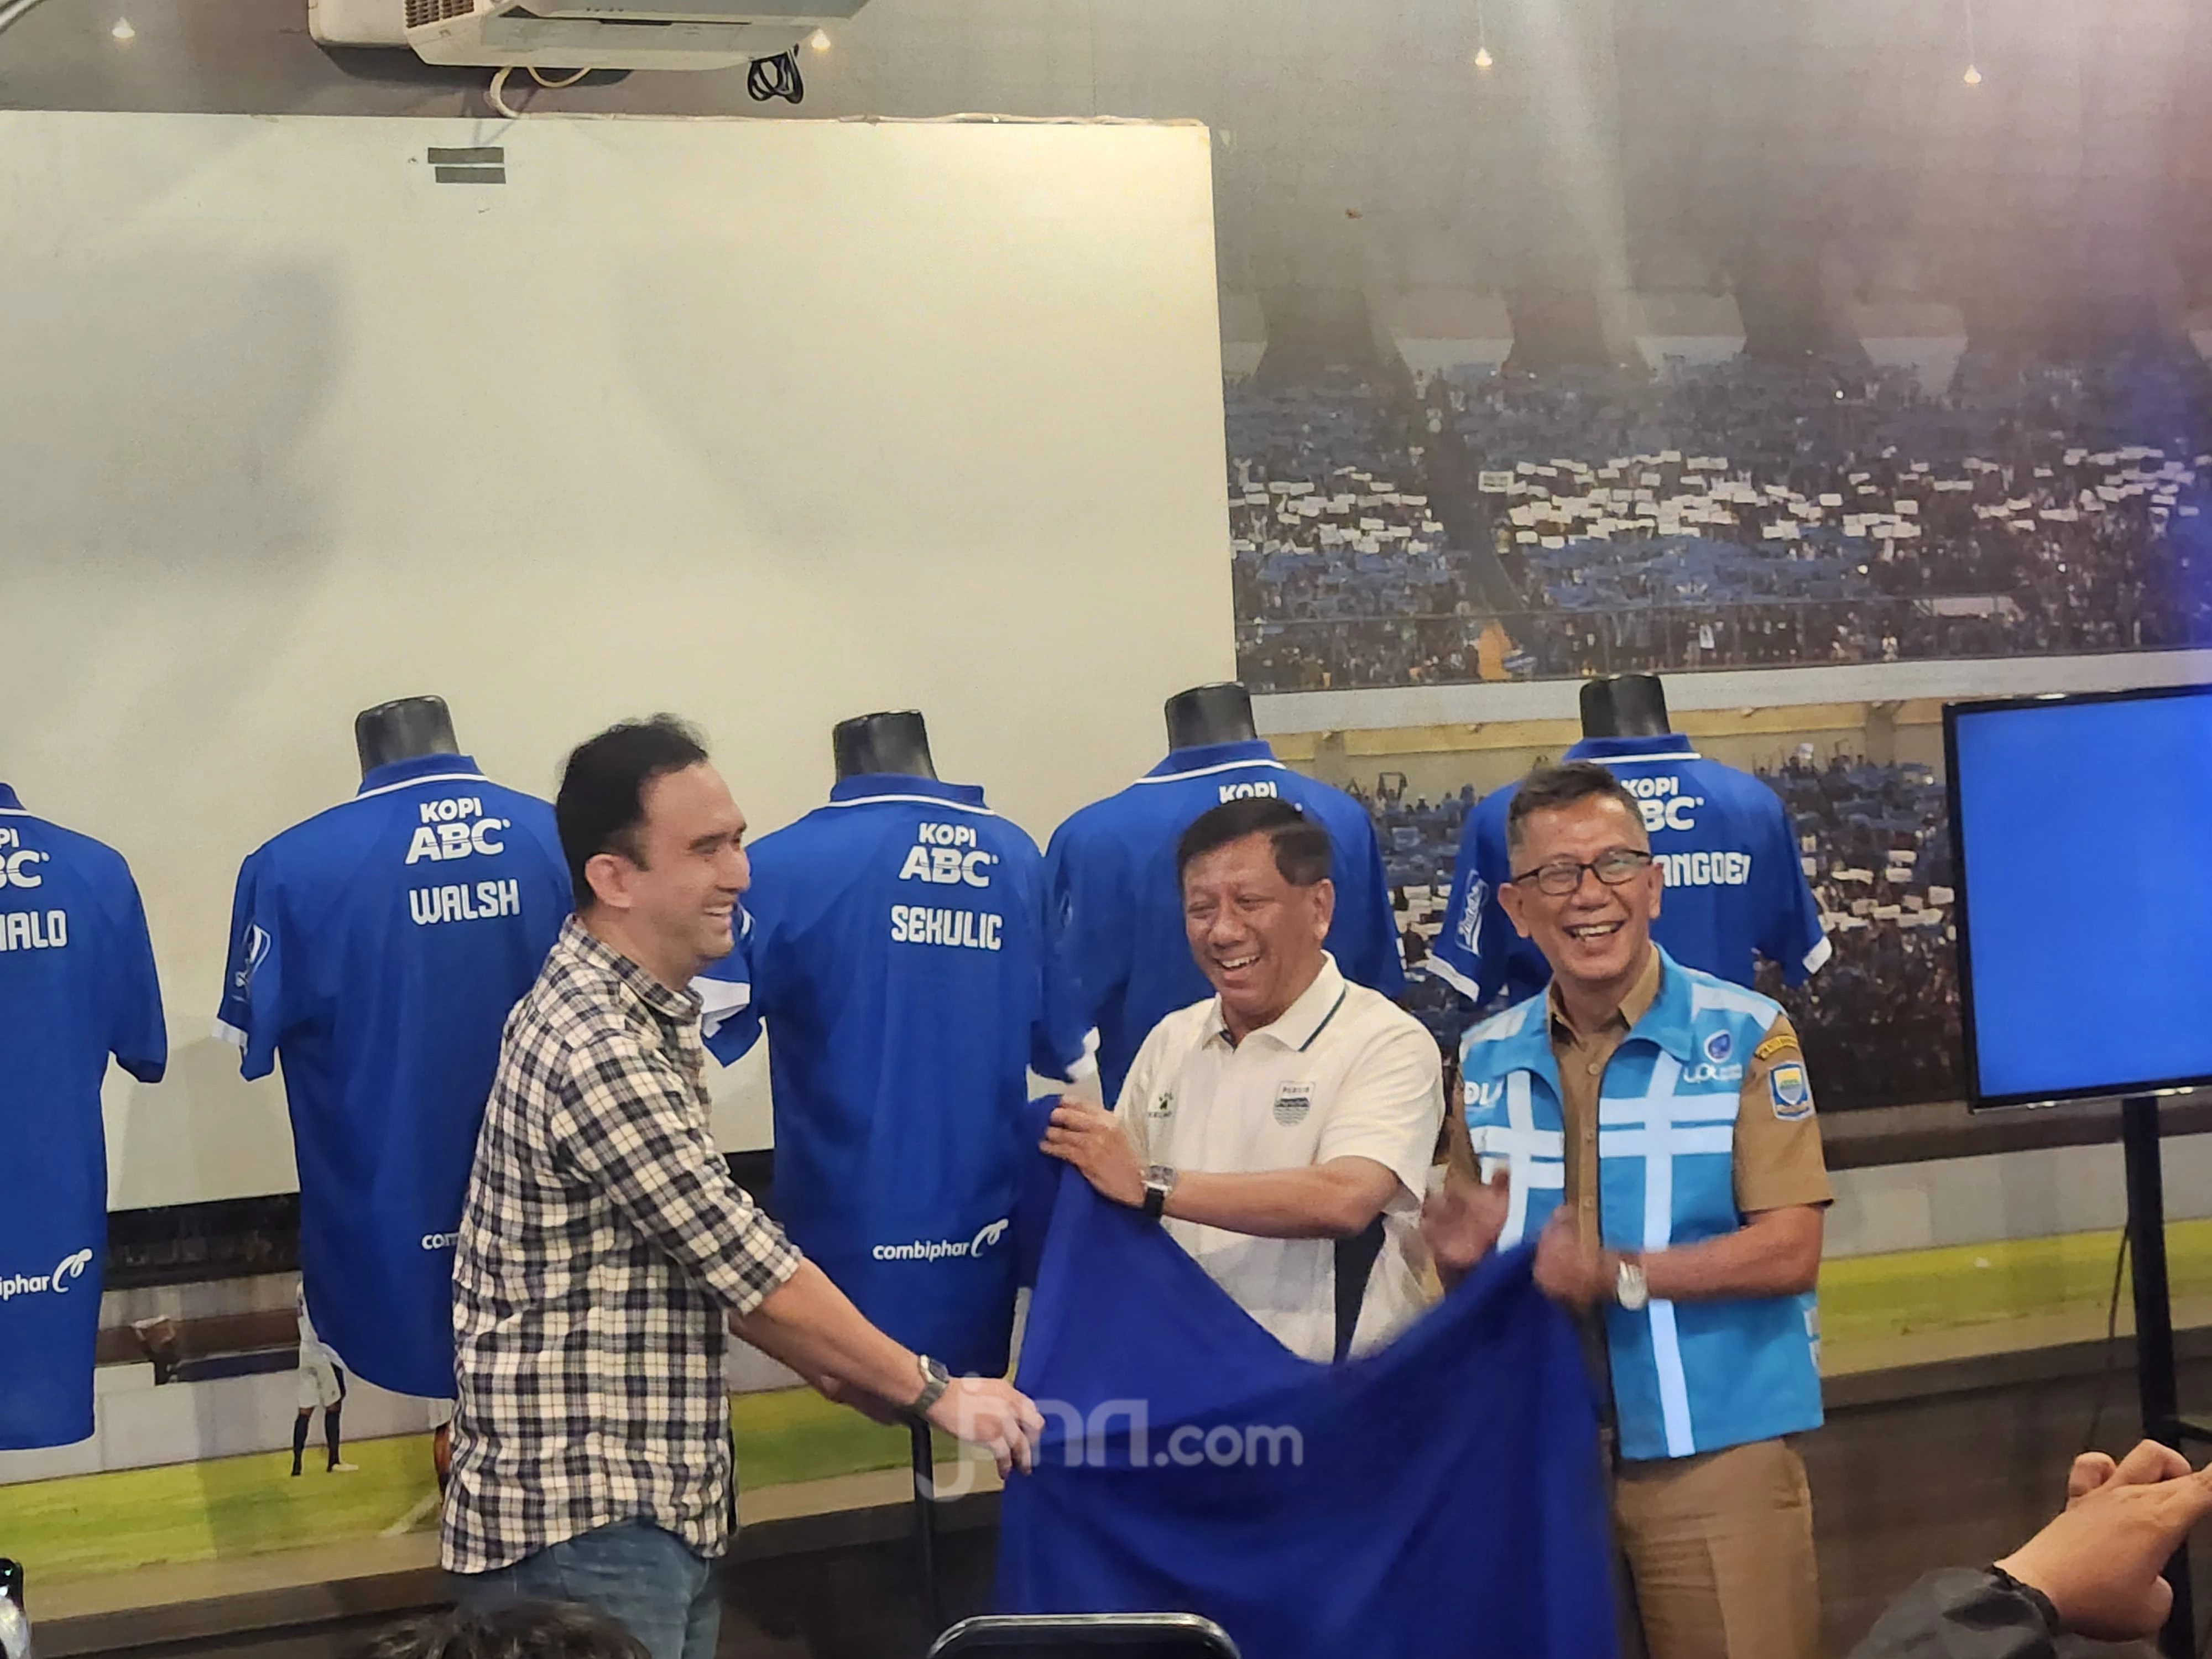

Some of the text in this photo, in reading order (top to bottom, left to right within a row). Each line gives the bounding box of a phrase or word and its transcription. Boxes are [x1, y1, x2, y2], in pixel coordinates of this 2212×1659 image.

[1621, 776, 1679, 797] KOPI
[420, 797, 482, 823] KOPI
[405, 818, 504, 865] ABC
[918, 823, 977, 848] KOPI
[899, 846, 990, 887] ABC
[409, 878, 520, 926] WALSH
[891, 904, 1003, 951] SEKULIC
[873, 1239, 970, 1263] combiphar
